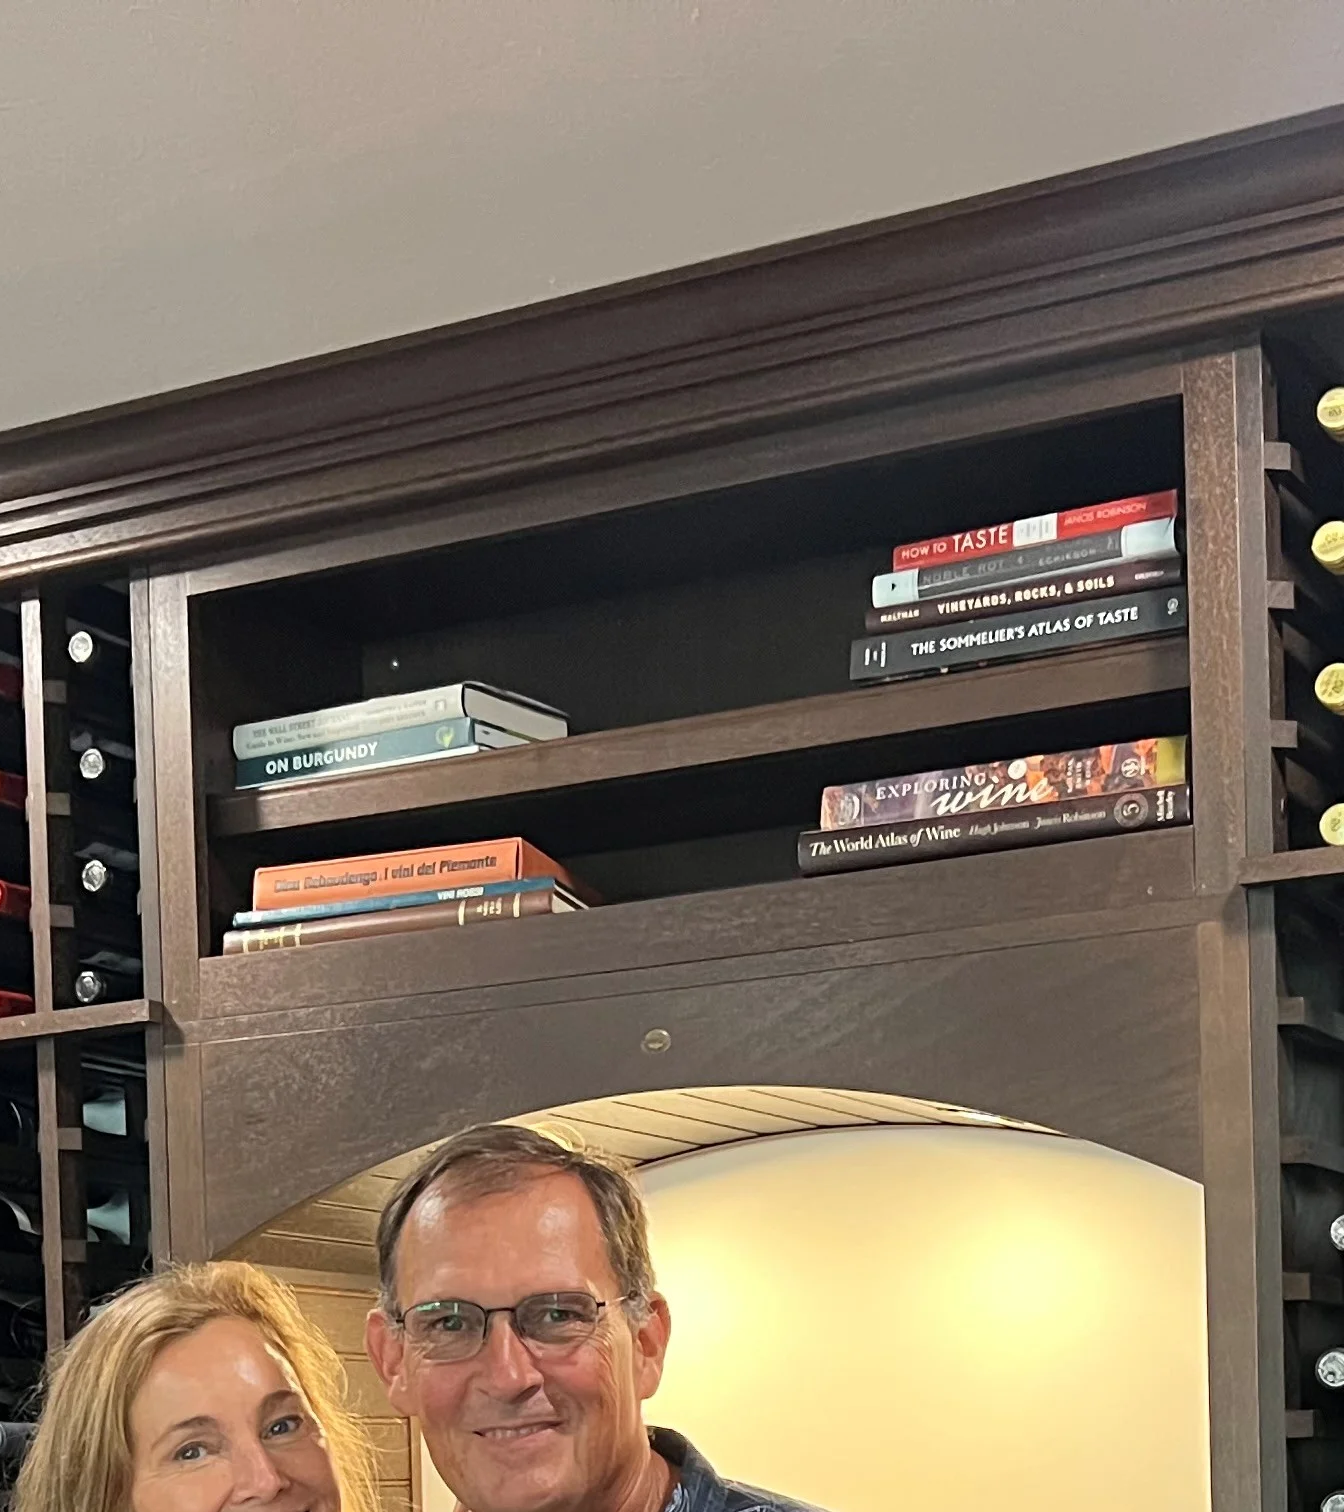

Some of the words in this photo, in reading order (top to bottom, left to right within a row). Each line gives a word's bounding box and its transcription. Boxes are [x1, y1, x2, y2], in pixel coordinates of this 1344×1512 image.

[1097, 502, 1147, 521] ROBINSON
[901, 545, 929, 561] HOW
[932, 541, 947, 554] TO
[952, 525, 1008, 553] TASTE
[937, 593, 1011, 615] VINEYARDS,
[1014, 583, 1062, 603] ROCKS,
[1063, 581, 1075, 595] &
[1076, 575, 1115, 593] SOILS
[911, 638, 936, 656] THE
[939, 625, 1025, 653] SOMMELIER'S
[1027, 618, 1071, 638] ATLAS
[1074, 614, 1094, 629] OF
[1097, 606, 1139, 624] TASTE
[265, 757, 289, 775] ON
[293, 741, 378, 772] BURGUNDY
[876, 772, 988, 801] EXPLORING
[930, 776, 1054, 816] wine
[810, 841, 833, 857] The
[834, 835, 873, 854] World
[875, 832, 909, 849] Atlas
[910, 827, 925, 847] of
[926, 825, 961, 844] Wine
[439, 856, 497, 874] Piemonte
